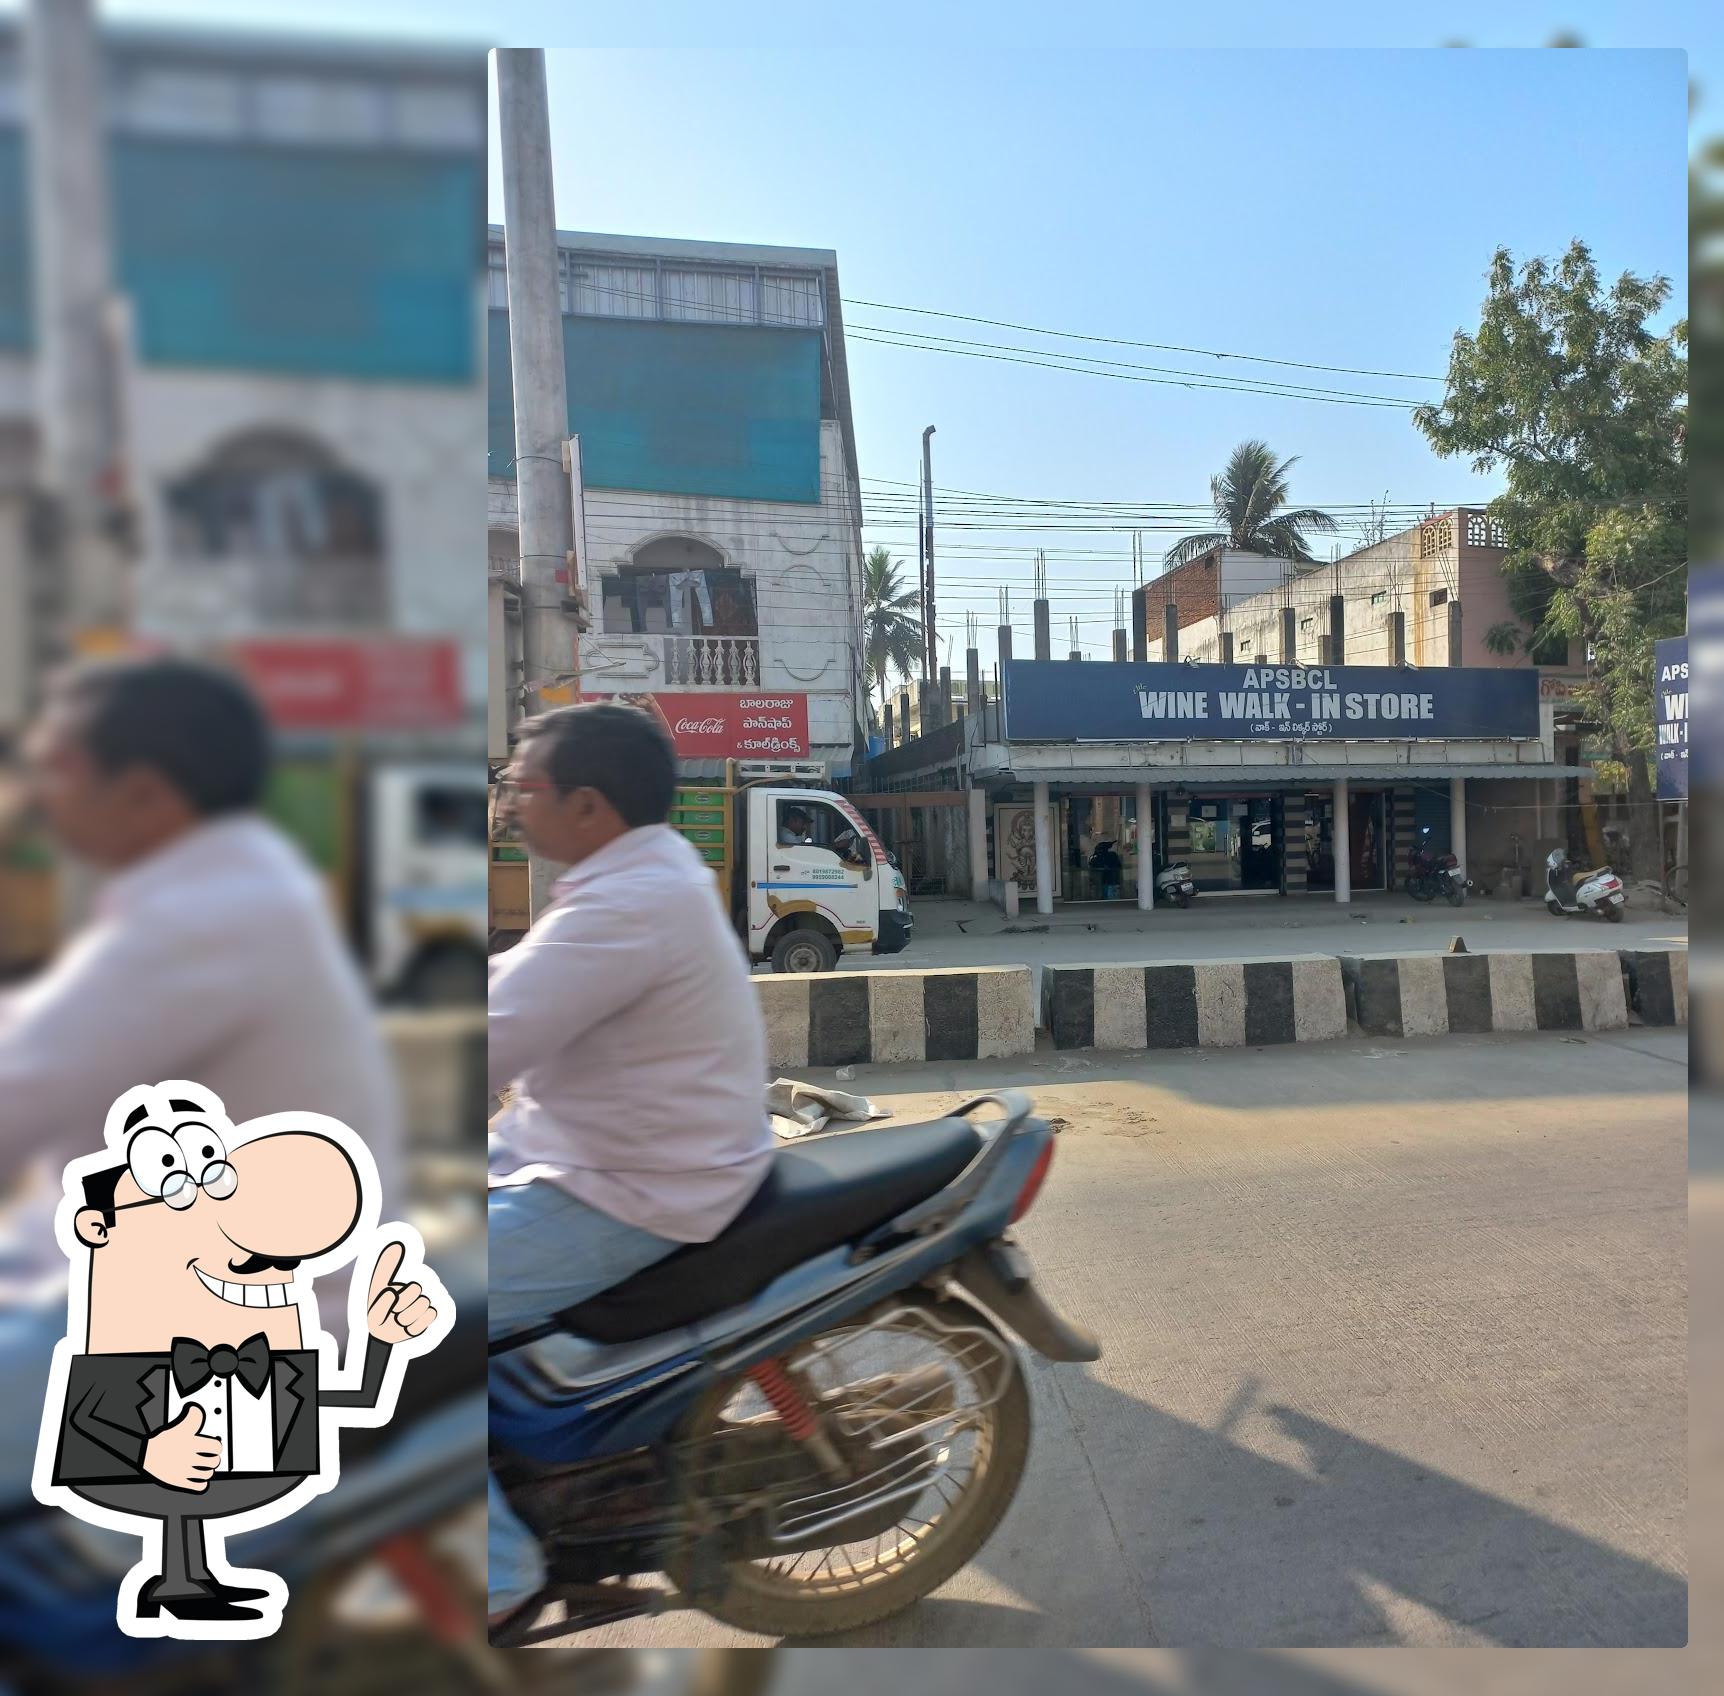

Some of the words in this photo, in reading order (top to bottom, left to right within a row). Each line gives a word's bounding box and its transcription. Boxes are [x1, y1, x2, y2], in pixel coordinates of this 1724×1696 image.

[1243, 668, 1337, 690] APSBCL
[1138, 691, 1209, 719] WINE
[1218, 691, 1291, 719] WALK
[1311, 693, 1341, 719] IN
[1345, 693, 1434, 719] STORE
[675, 717, 726, 734] Coca-Cola
